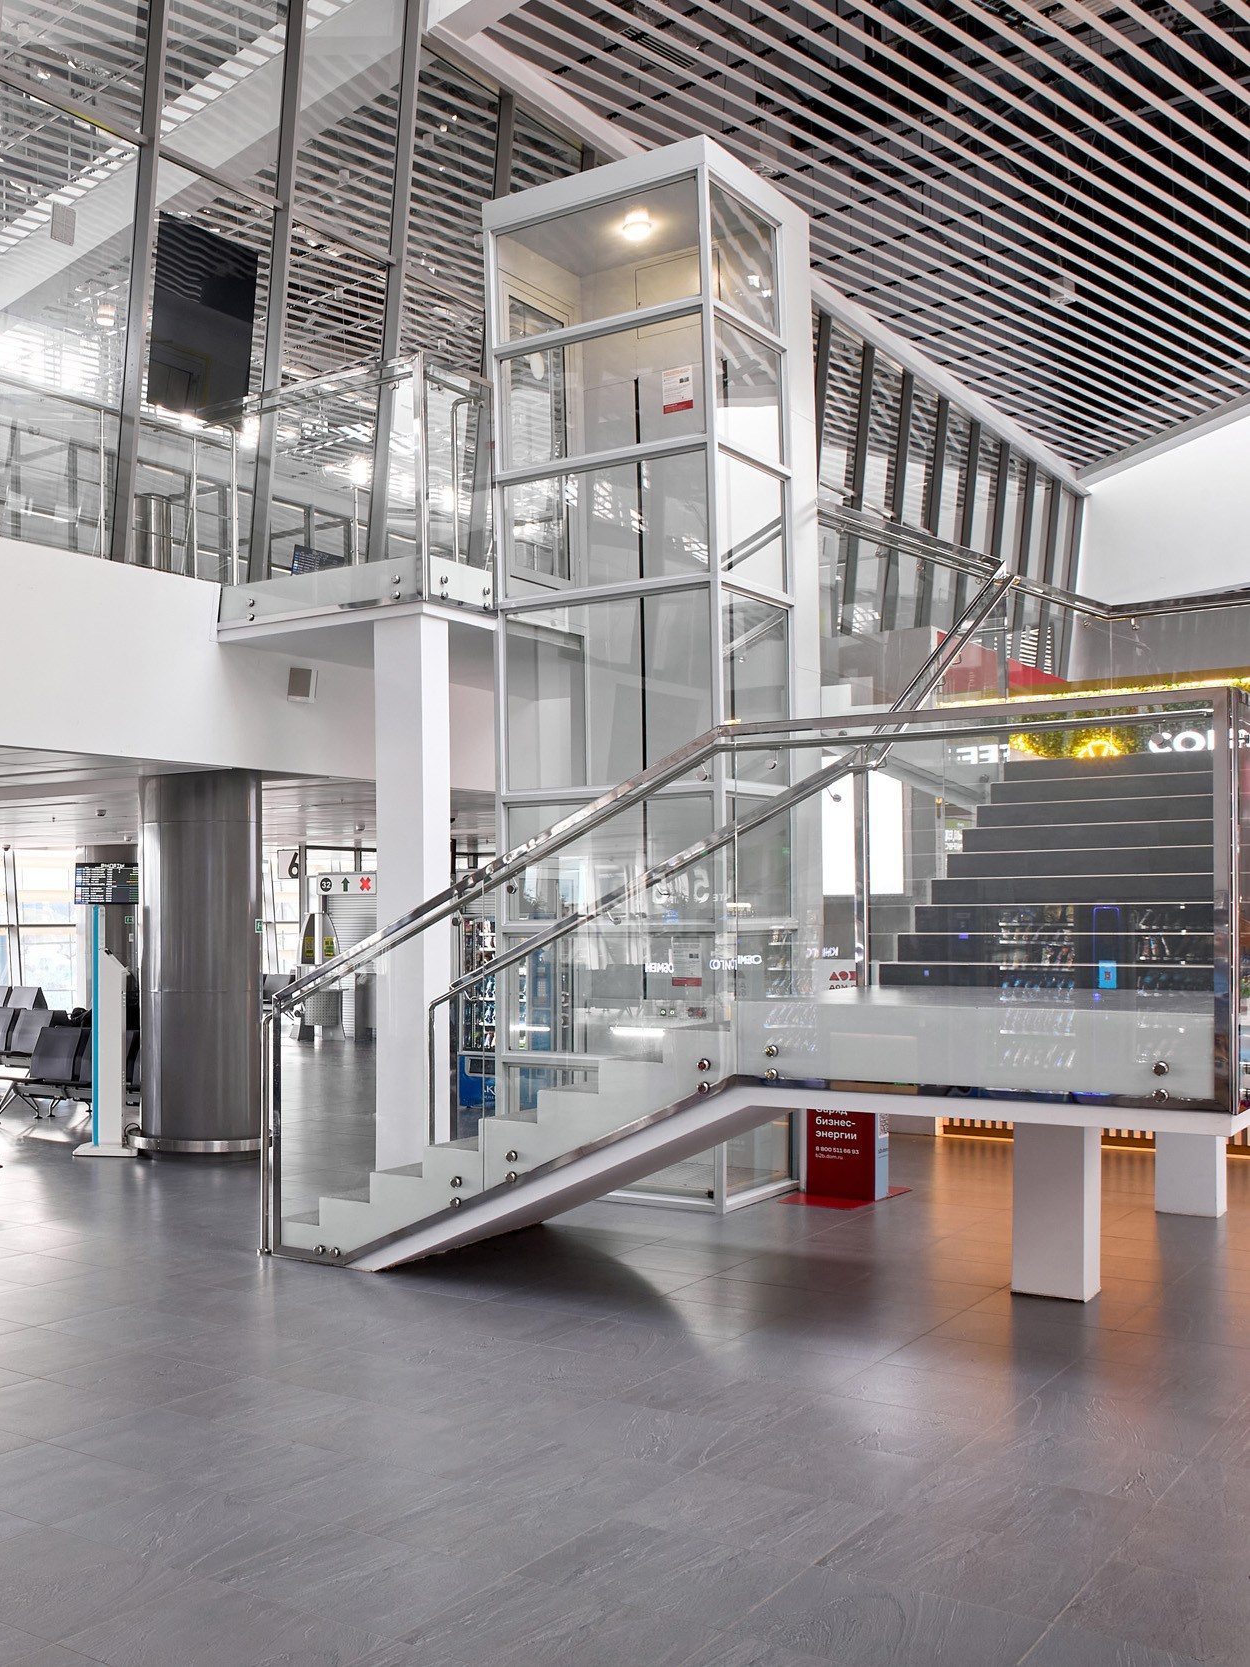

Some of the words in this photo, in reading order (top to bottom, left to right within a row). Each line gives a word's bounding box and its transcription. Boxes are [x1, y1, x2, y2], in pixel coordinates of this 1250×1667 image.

[287, 851, 299, 879] 6
[321, 880, 332, 890] 32
[815, 1116, 856, 1128] бизнес-
[815, 1130, 857, 1141] энергии
[815, 1153, 844, 1161] b2b.dom.ru
